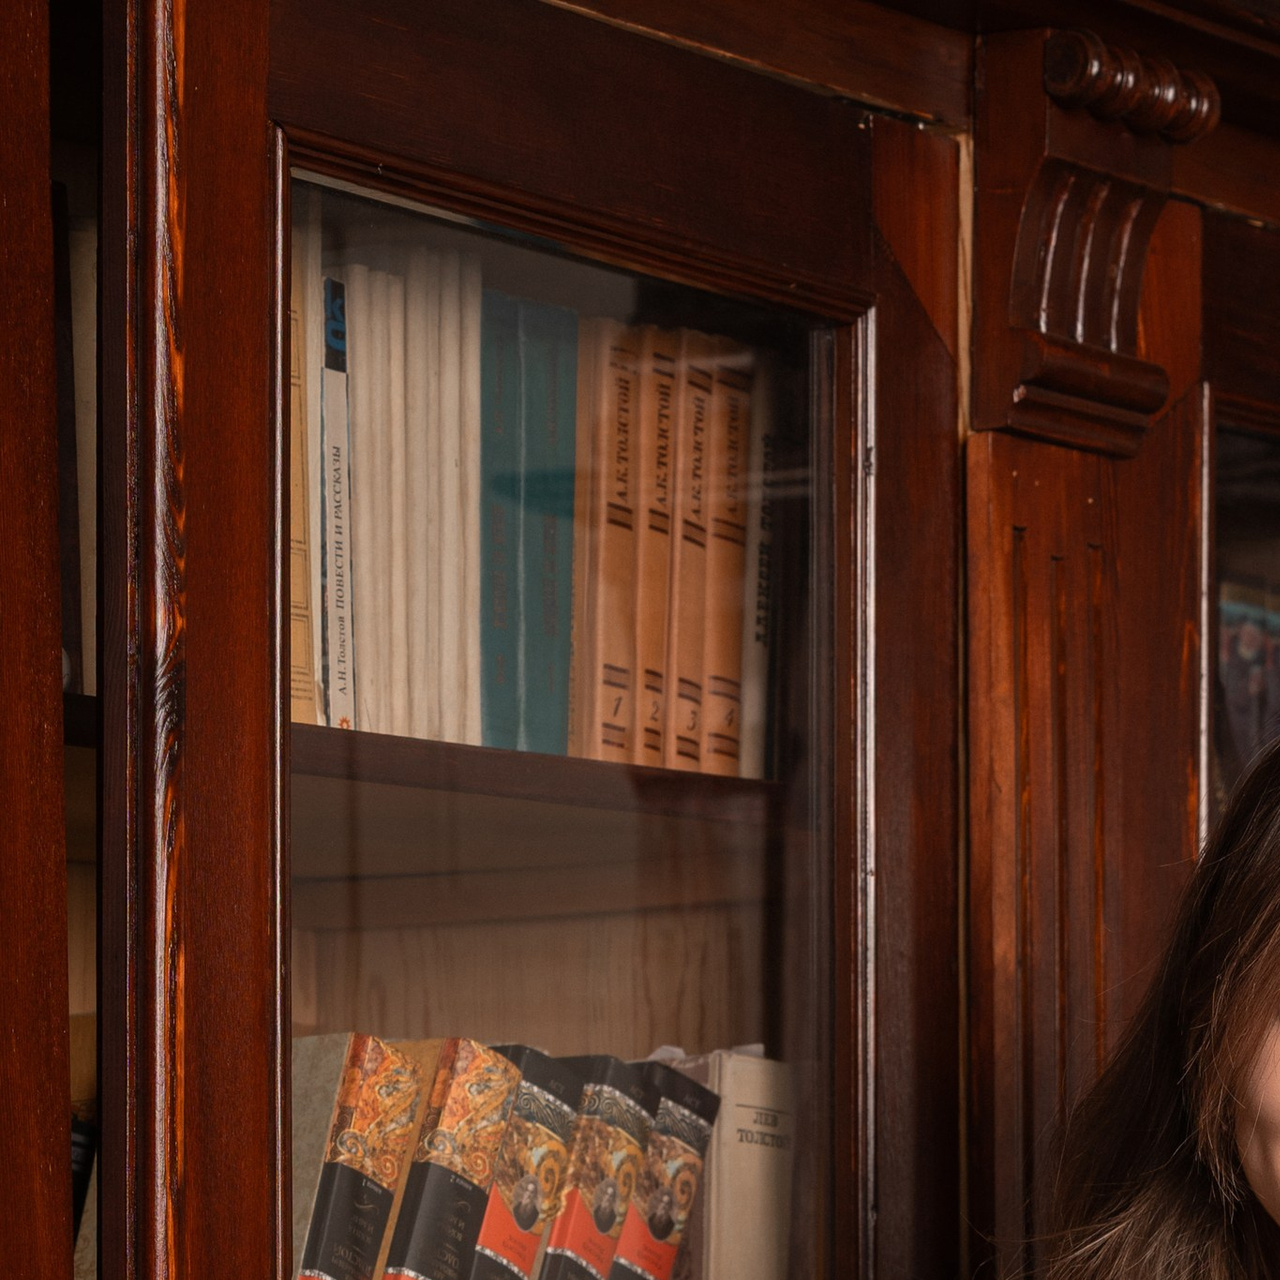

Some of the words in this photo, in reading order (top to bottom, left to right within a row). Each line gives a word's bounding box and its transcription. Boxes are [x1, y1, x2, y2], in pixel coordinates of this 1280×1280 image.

[332, 445, 343, 520] РАССКАЗЫ
[335, 524, 343, 536] И
[335, 541, 345, 609] ПОВЕСТИ
[613, 696, 623, 718] 1
[687, 709, 698, 732] 3
[753, 1111, 779, 1128] ЛЕВ
